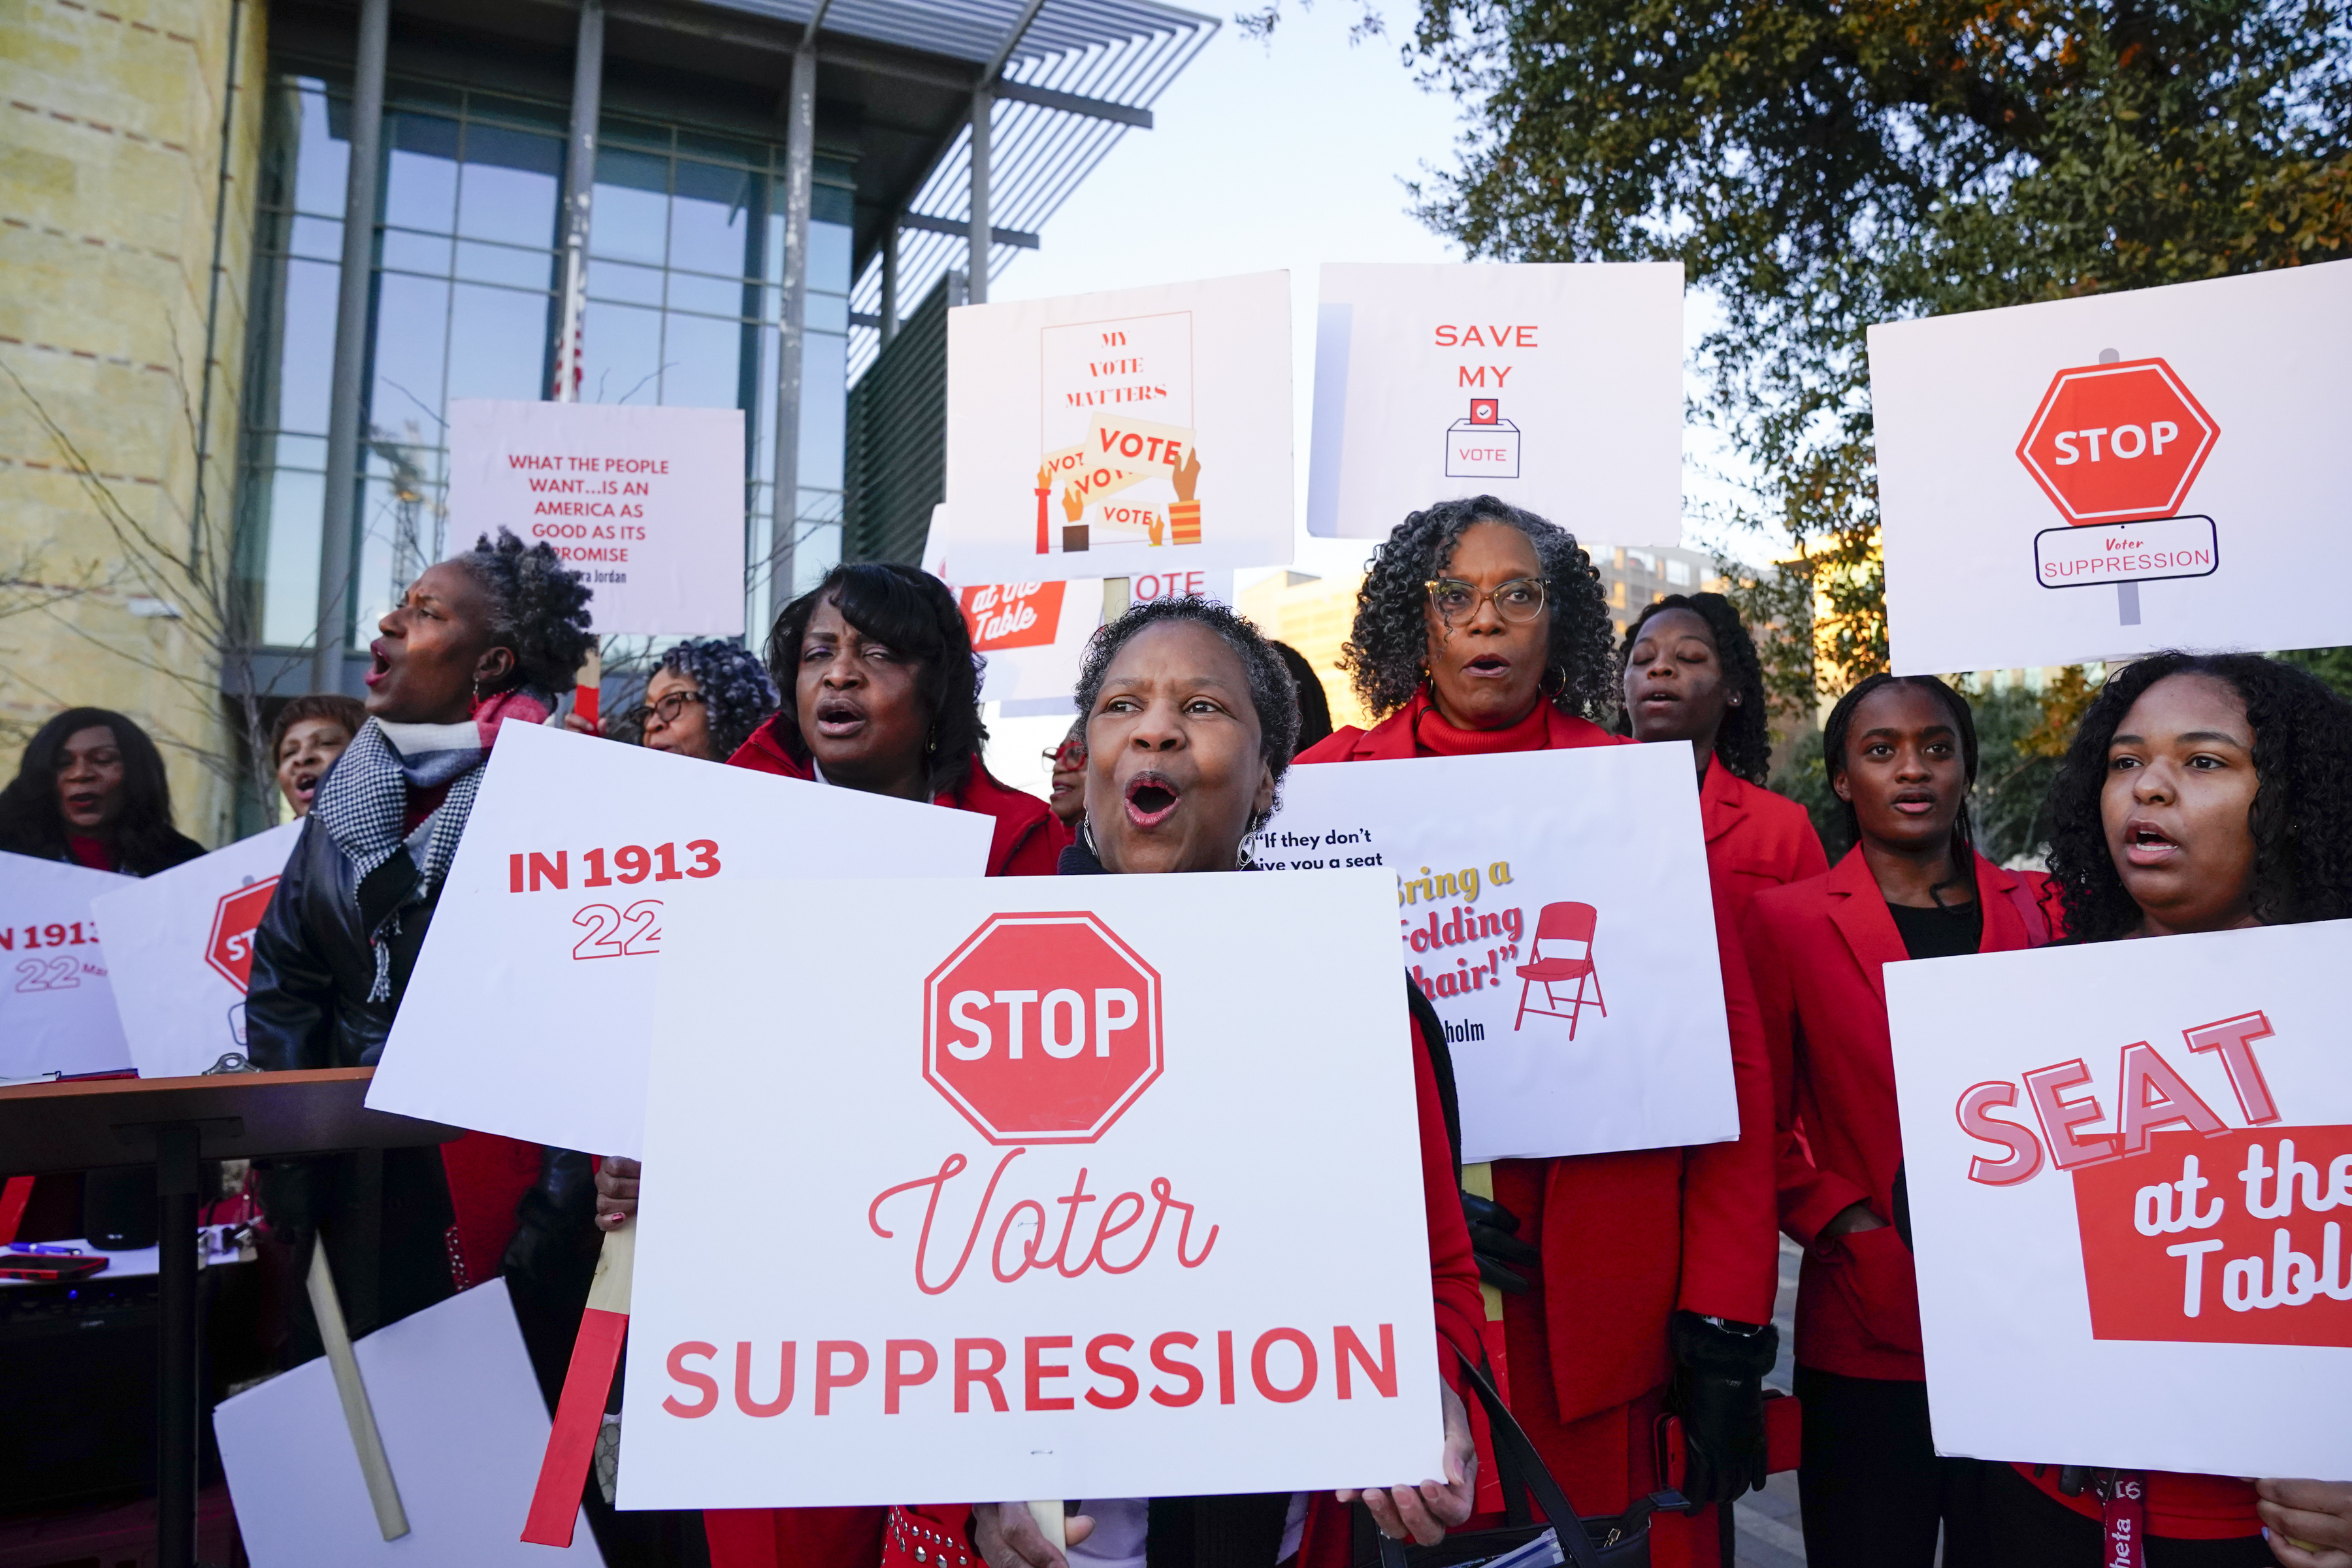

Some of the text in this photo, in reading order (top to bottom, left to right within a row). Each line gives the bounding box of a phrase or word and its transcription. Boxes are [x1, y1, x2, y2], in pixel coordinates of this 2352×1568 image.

[1102, 330, 1130, 348] MY
[1435, 325, 1538, 348] SAVE
[1090, 357, 1143, 377] VOTE
[1458, 366, 1513, 387] MY
[1066, 384, 1168, 408] MATTERS
[1100, 427, 1182, 466] VOTE
[1460, 448, 1507, 461] VOTE
[2054, 420, 2178, 466] STOP
[509, 454, 669, 474] WHAT THE PEOPLE
[1049, 452, 1084, 473] VOT
[623, 482, 649, 496] AN
[1074, 468, 1133, 495] VO
[534, 500, 644, 518] AMERICA AS
[1104, 506, 1152, 526] VOTE
[532, 523, 646, 540] GOOD AS ITS
[2105, 538, 2144, 551] Voter
[594, 569, 627, 583] Jordan
[2044, 549, 2210, 578] SUPPRESSION
[971, 583, 999, 613] at
[1135, 571, 1206, 601] OTE
[973, 600, 1037, 645] Table
[1281, 832, 1320, 850] they
[1325, 828, 1371, 845] don’t
[510, 839, 721, 893] IN 1913
[1256, 853, 1382, 871] ive you a seat
[1397, 861, 1513, 907] ring a
[0, 921, 100, 951] N 191
[572, 899, 664, 960] 22
[1401, 906, 1522, 953] olding
[226, 928, 257, 962] ST
[15, 955, 81, 993] 22
[1412, 943, 1517, 1001] hair!”
[947, 987, 1139, 1061] STOP
[1445, 1019, 1485, 1043] holm
[1955, 1009, 2281, 1187] SEAT
[2134, 1138, 2352, 1236] at the
[868, 1147, 1220, 1296] Voter
[2166, 1221, 2352, 1318] Tabl
[661, 1323, 1399, 1419] SUPPRESSION
[2109, 1518, 2131, 1568] heta
